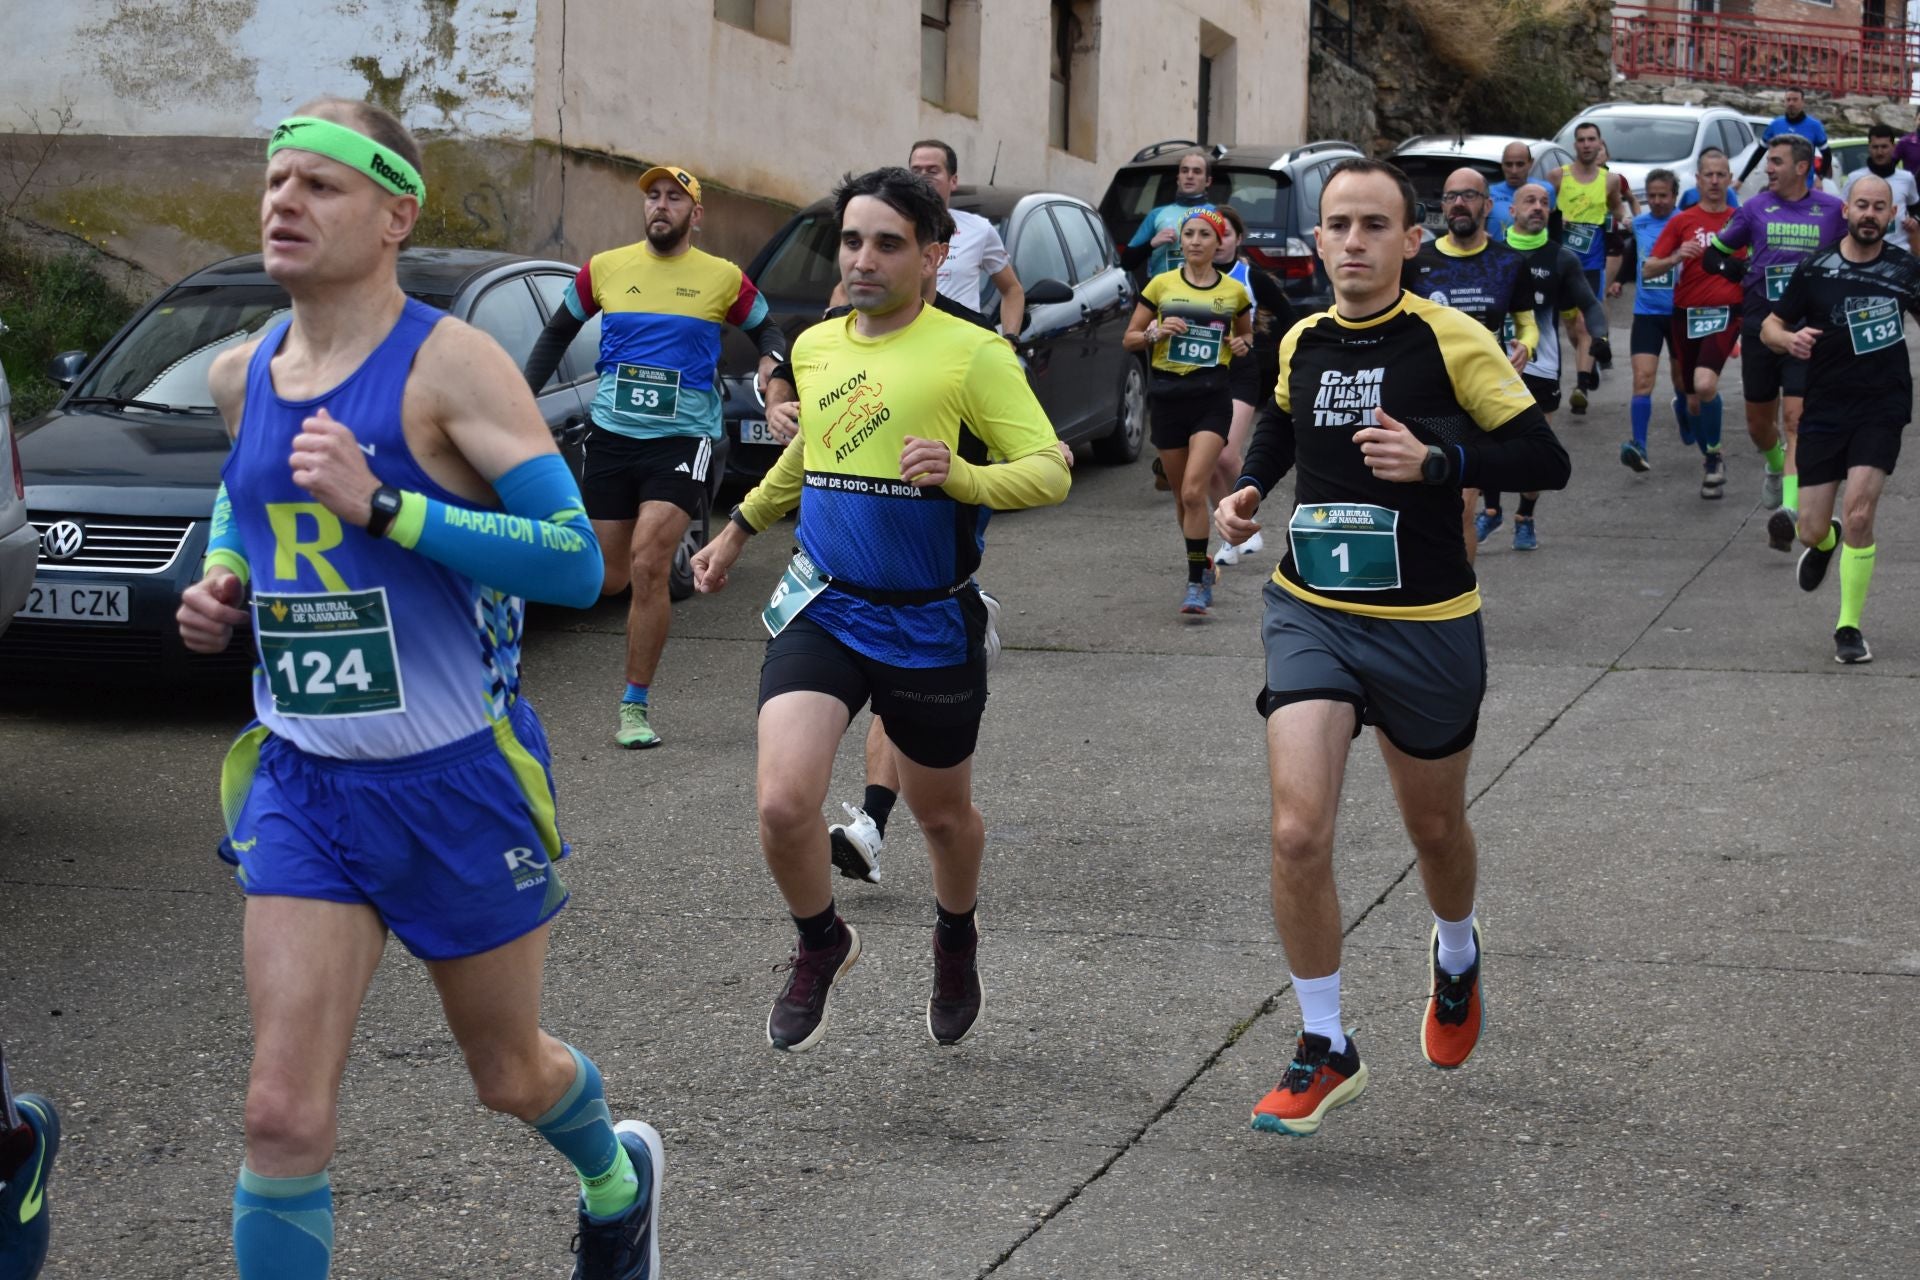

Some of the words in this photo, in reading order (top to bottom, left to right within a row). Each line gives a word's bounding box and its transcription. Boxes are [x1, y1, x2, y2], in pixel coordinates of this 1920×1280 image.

[1184, 208, 1223, 225] ECUADOR
[1767, 222, 1819, 238] BEHOBIA
[1694, 319, 1722, 332] 237
[1862, 320, 1897, 343] 132
[1178, 342, 1211, 360] 190
[631, 388, 660, 408] 53
[818, 369, 867, 412] RINCON
[834, 407, 891, 464] ATLETISMO
[829, 478, 841, 489] DE
[891, 485, 922, 498] RIOJA
[1327, 516, 1337, 524] DE
[1338, 516, 1375, 525] NAVARRA
[1328, 509, 1345, 517] CAJA
[1346, 509, 1371, 518] RURAL
[444, 505, 534, 544] MARATON
[265, 502, 351, 593] R
[1331, 542, 1350, 573] 1
[19, 588, 58, 614] 21
[71, 590, 121, 616] CZK
[290, 602, 315, 614] CAJA
[316, 600, 352, 613] RURAL
[293, 613, 306, 624] DE
[307, 610, 359, 624] NAVARRA
[277, 648, 372, 694] 124
[504, 846, 548, 871] R
[516, 875, 547, 891] RIOJA
